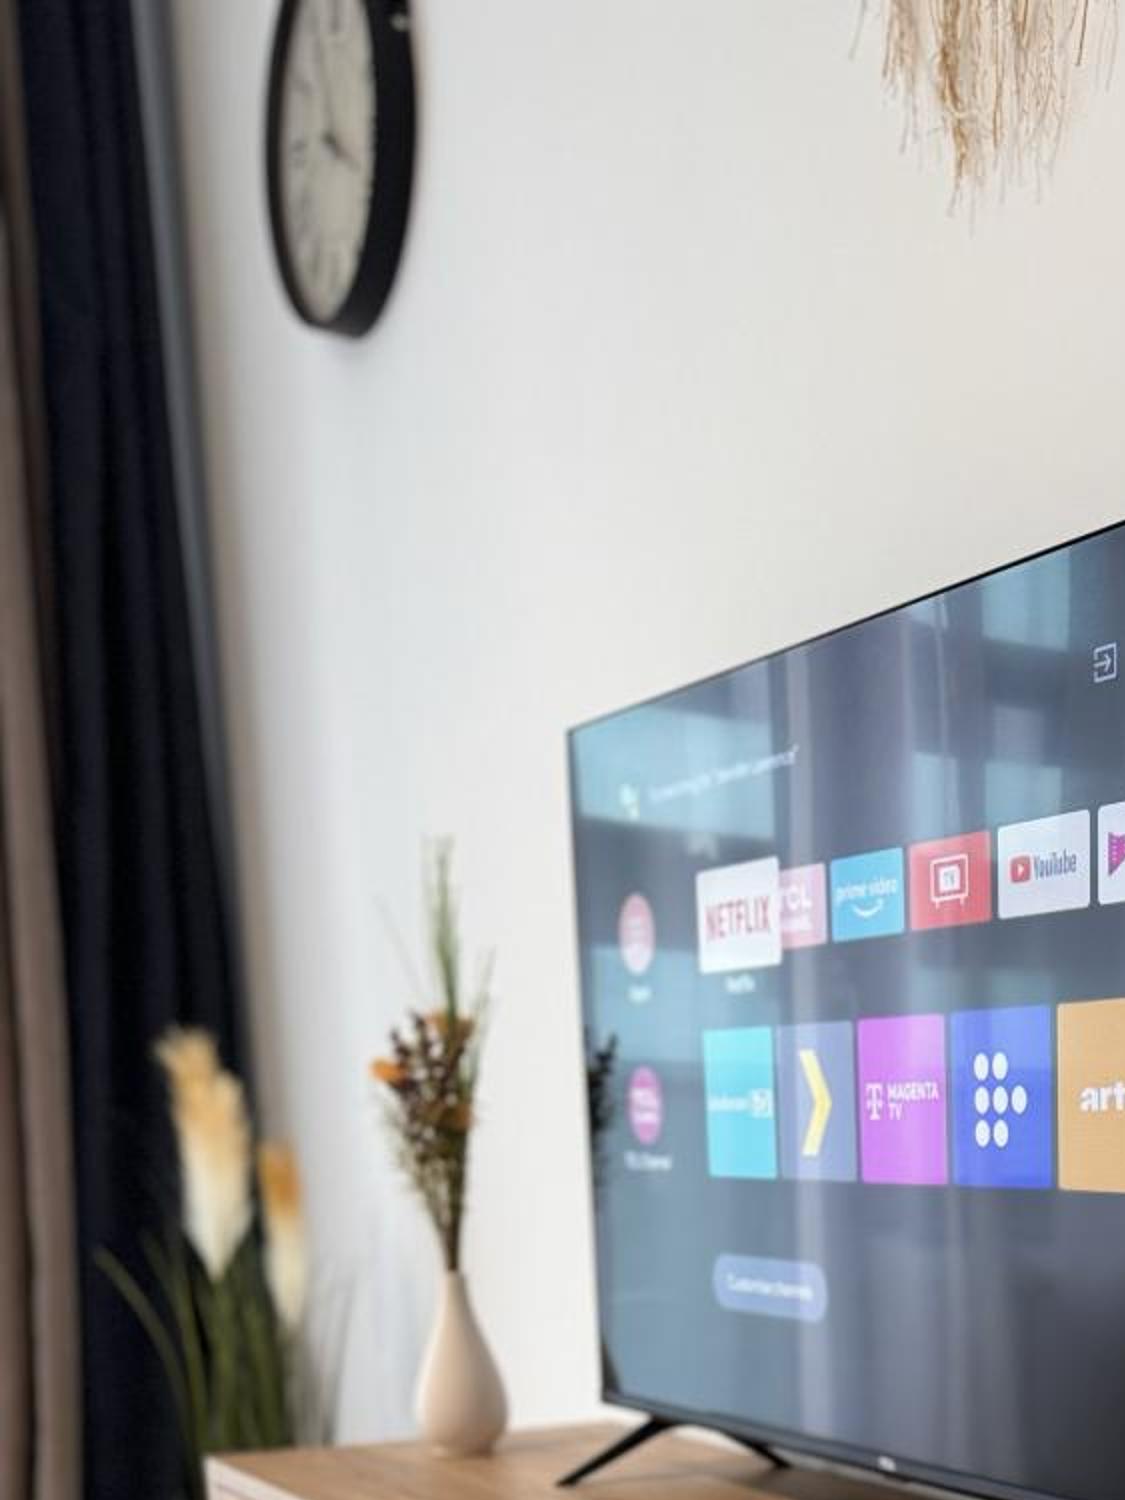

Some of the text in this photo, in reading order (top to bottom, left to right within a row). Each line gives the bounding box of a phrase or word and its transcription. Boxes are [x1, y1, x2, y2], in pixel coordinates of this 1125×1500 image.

[1033, 848, 1077, 880] YouTube
[704, 896, 769, 942] NETFLIX
[887, 1082, 940, 1101] MAGENTA
[888, 1102, 903, 1121] TV
